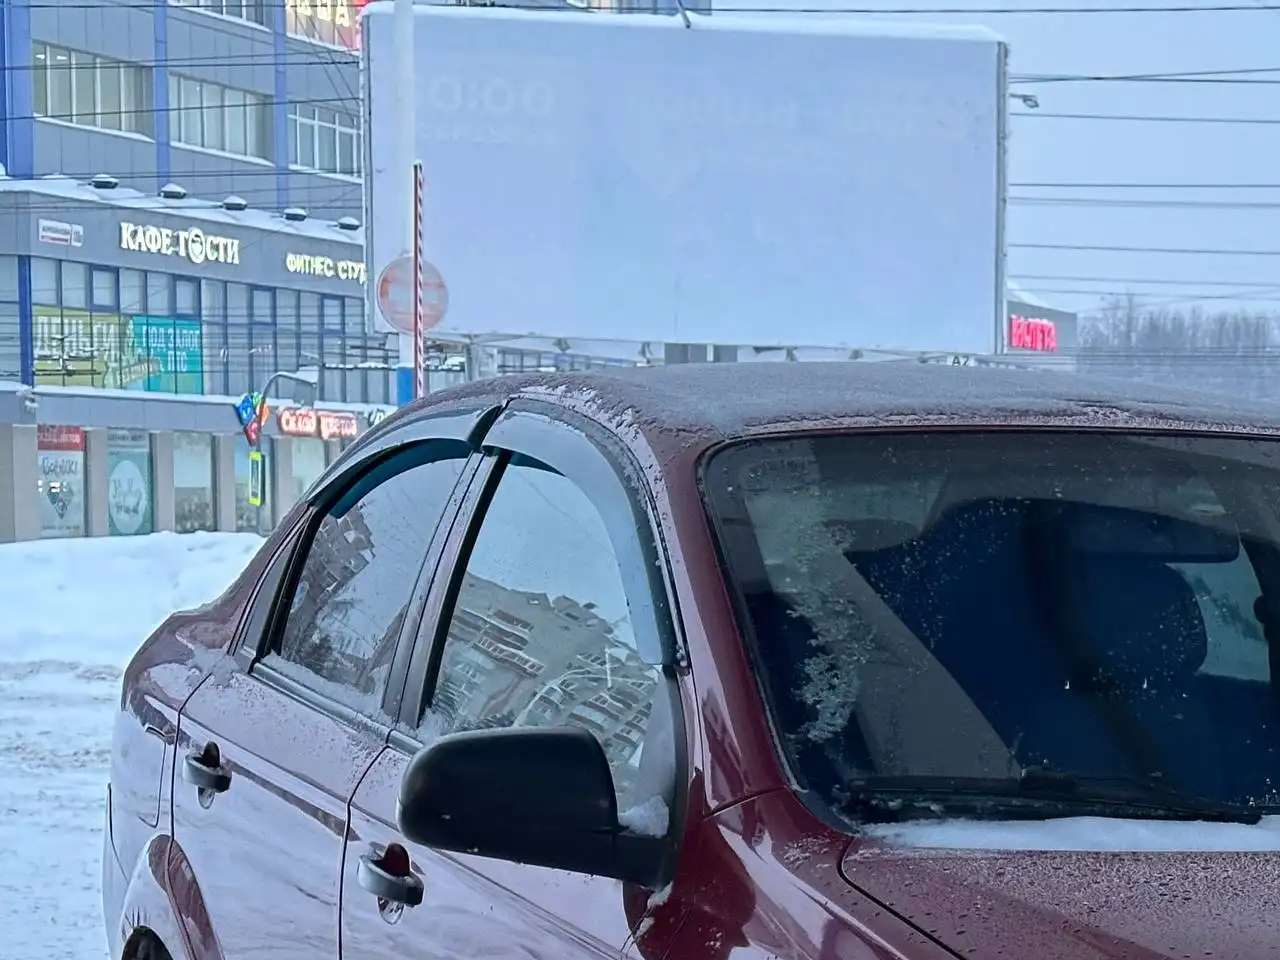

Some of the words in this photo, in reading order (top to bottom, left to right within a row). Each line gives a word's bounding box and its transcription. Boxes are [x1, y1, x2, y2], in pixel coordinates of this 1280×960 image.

[120, 222, 172, 255] КАФЕ
[176, 226, 239, 264] ГОСТИ
[286, 252, 334, 277] ФИТНЕС
[142, 325, 165, 351] ПОД
[168, 328, 200, 351] ЗАЛОГ
[168, 350, 188, 372] ПТС
